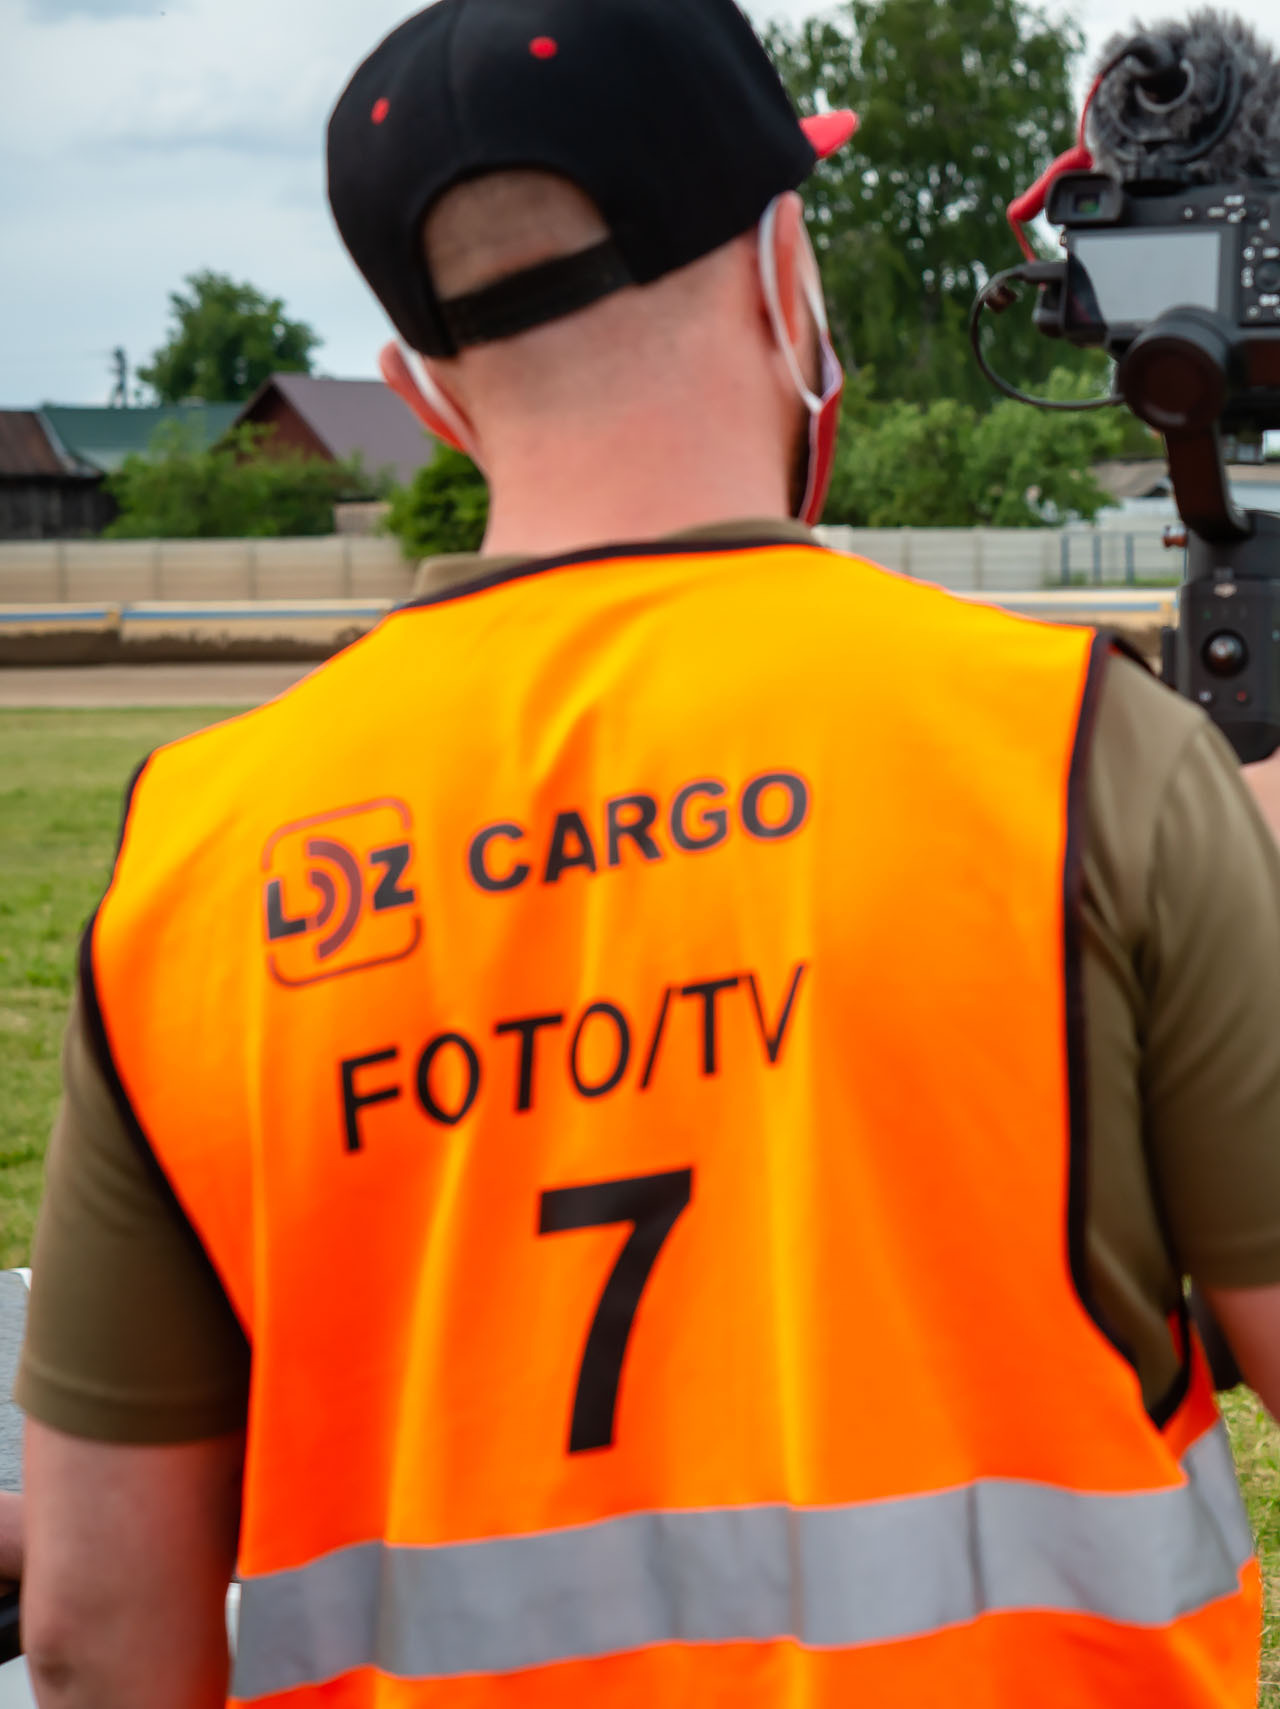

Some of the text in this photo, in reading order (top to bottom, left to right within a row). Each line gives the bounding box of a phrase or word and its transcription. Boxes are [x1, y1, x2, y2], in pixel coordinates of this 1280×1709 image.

[468, 773, 810, 892] CARGO
[340, 963, 804, 1153] FOTO/TV
[538, 1166, 692, 1454] 7
